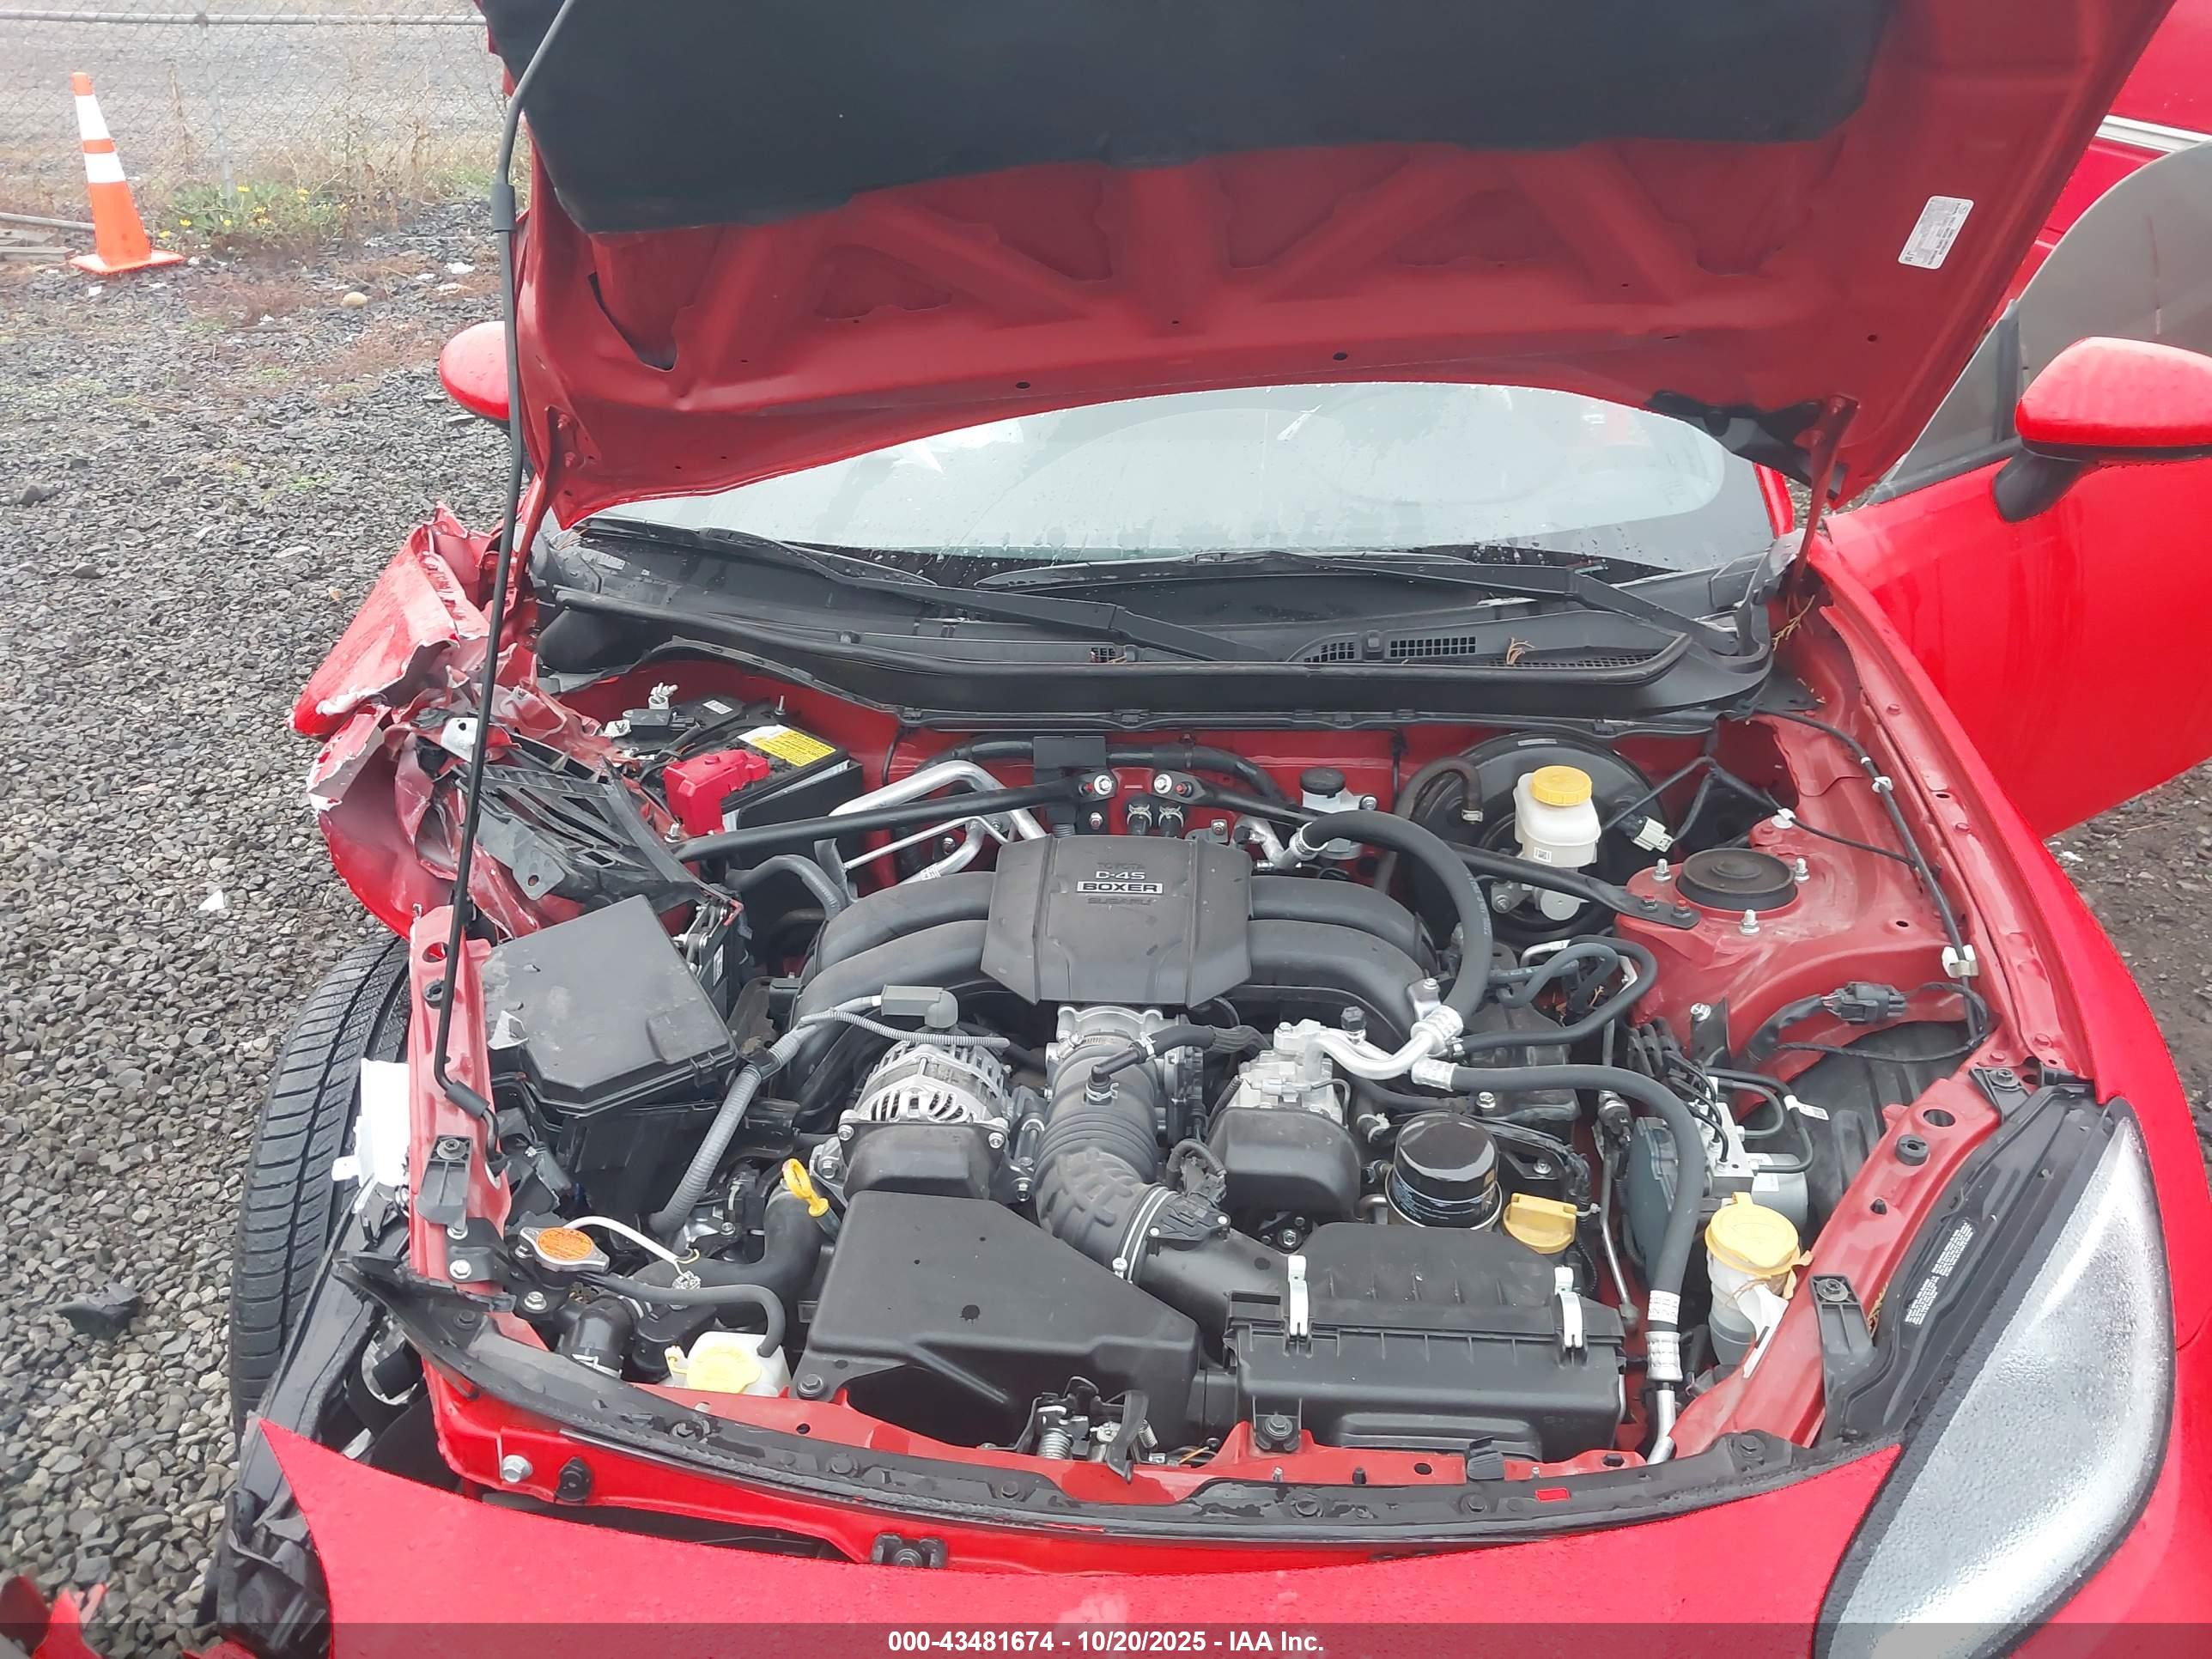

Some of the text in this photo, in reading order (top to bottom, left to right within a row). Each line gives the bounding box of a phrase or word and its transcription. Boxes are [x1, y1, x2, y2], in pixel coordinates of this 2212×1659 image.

[1095, 871, 1146, 880] D-4S
[1083, 883, 1158, 892] BOXER
[1087, 896, 1152, 906] SUBARU
